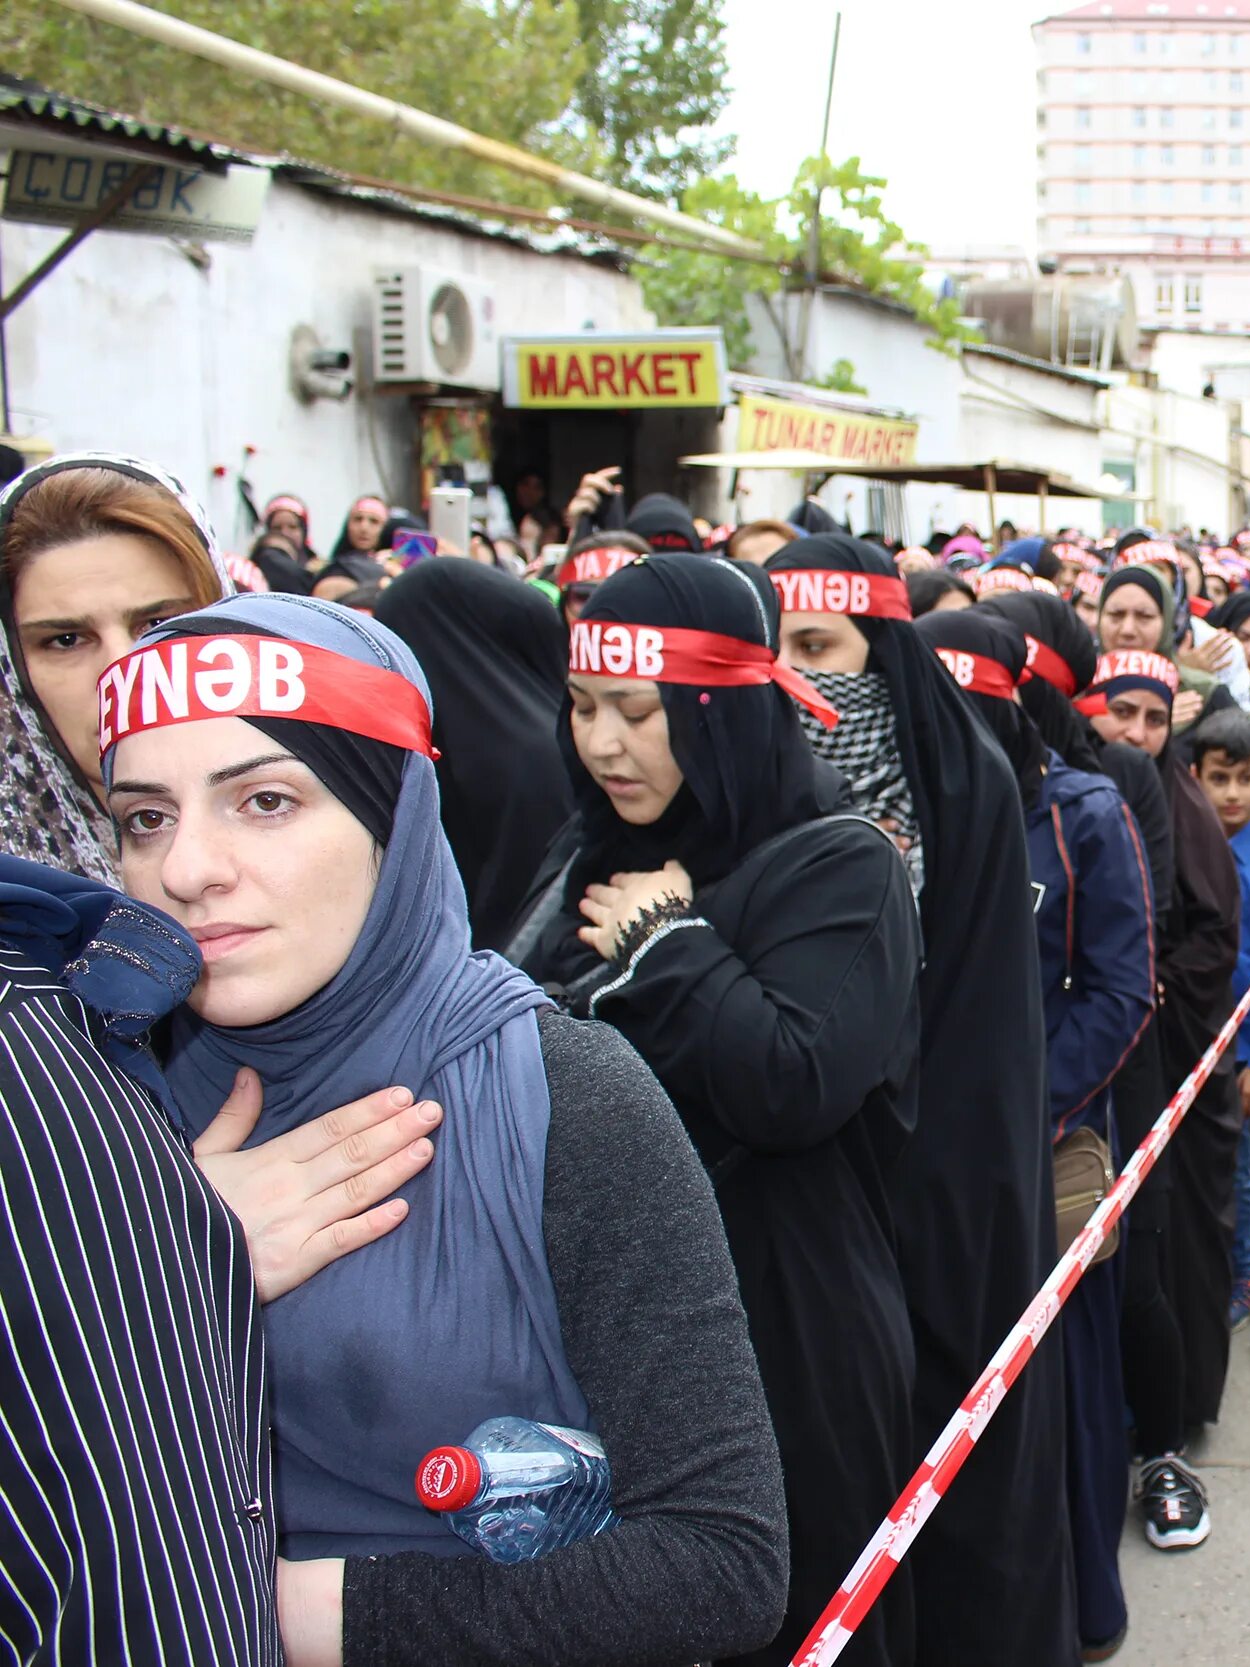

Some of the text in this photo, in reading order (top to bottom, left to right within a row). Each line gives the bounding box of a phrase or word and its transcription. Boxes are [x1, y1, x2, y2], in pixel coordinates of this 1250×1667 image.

[529, 352, 702, 398] MARKET
[753, 409, 915, 464] TUNAR MARKET
[100, 638, 306, 752] EYNƏB
